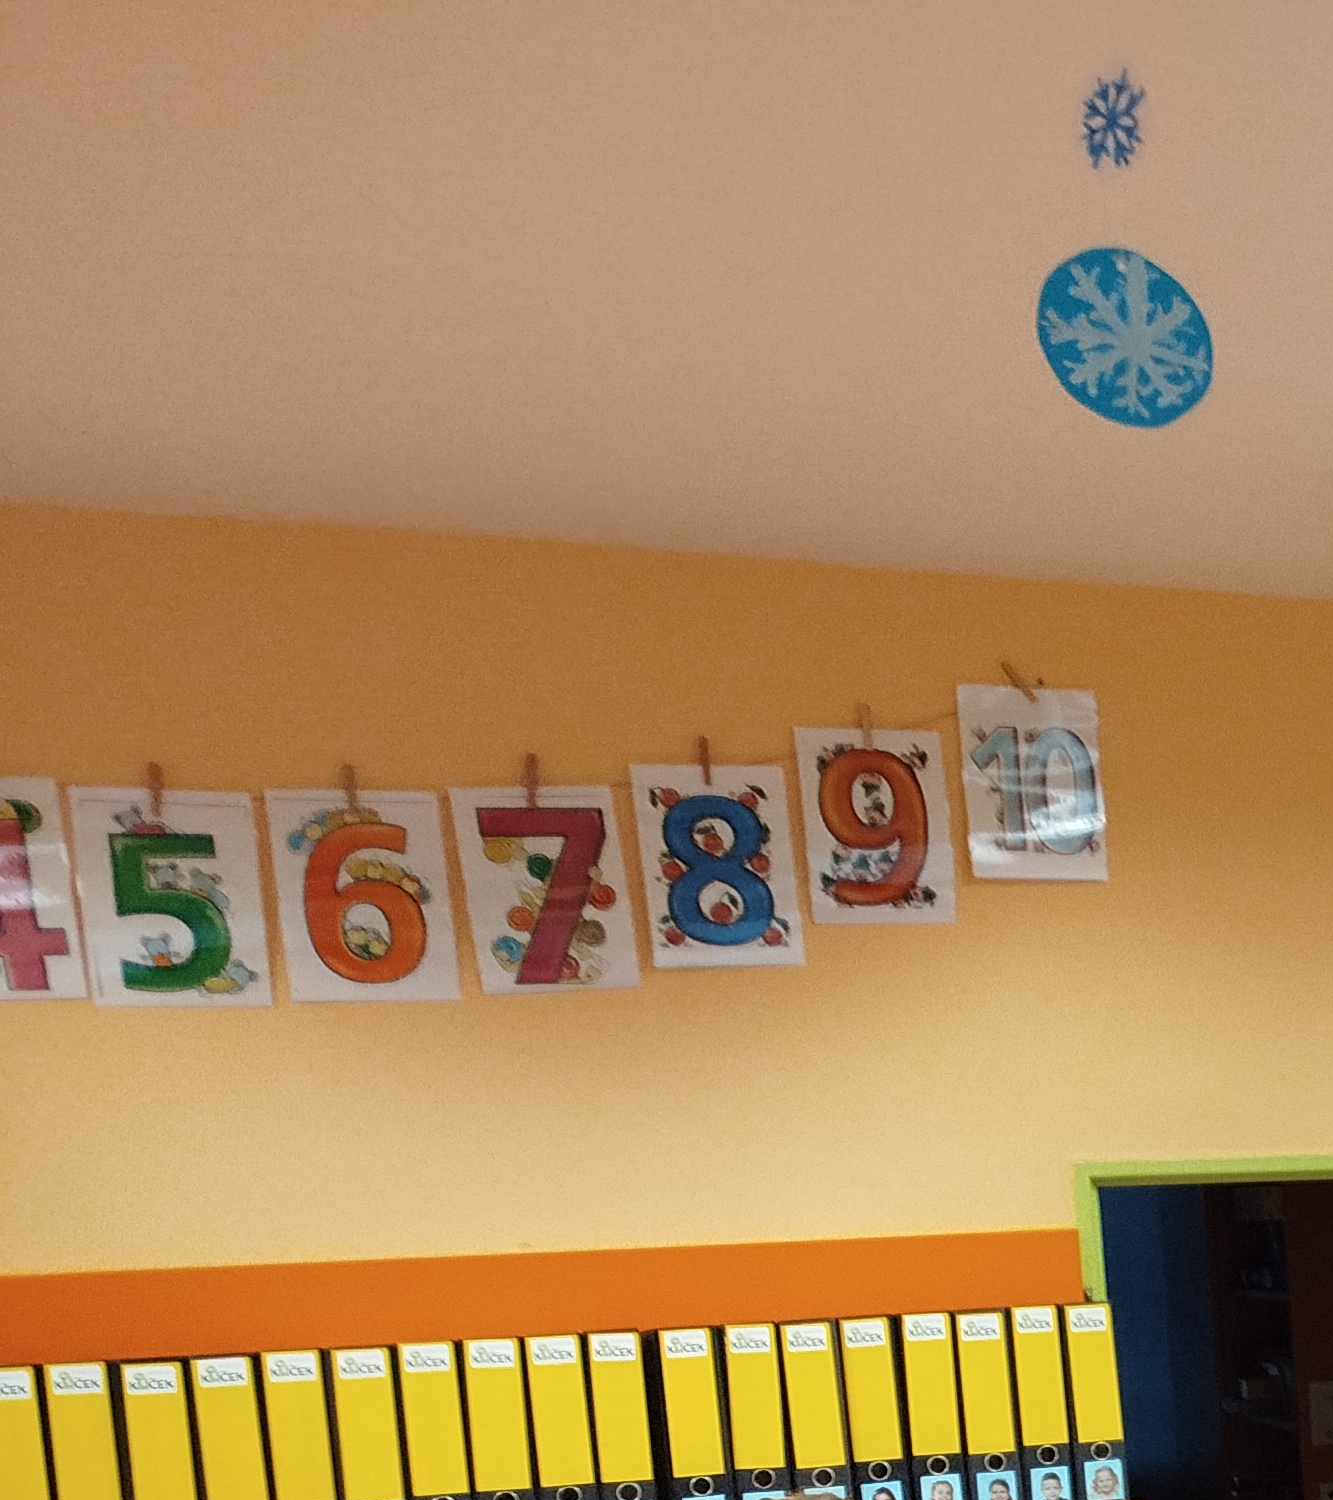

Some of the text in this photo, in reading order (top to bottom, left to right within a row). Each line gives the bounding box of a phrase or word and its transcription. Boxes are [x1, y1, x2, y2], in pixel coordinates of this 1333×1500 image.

[662, 794, 778, 946] 8
[816, 747, 929, 906] 9
[971, 726, 1101, 856] 10
[106, 832, 232, 991] 5
[304, 824, 427, 984] 6
[475, 807, 602, 985] 7
